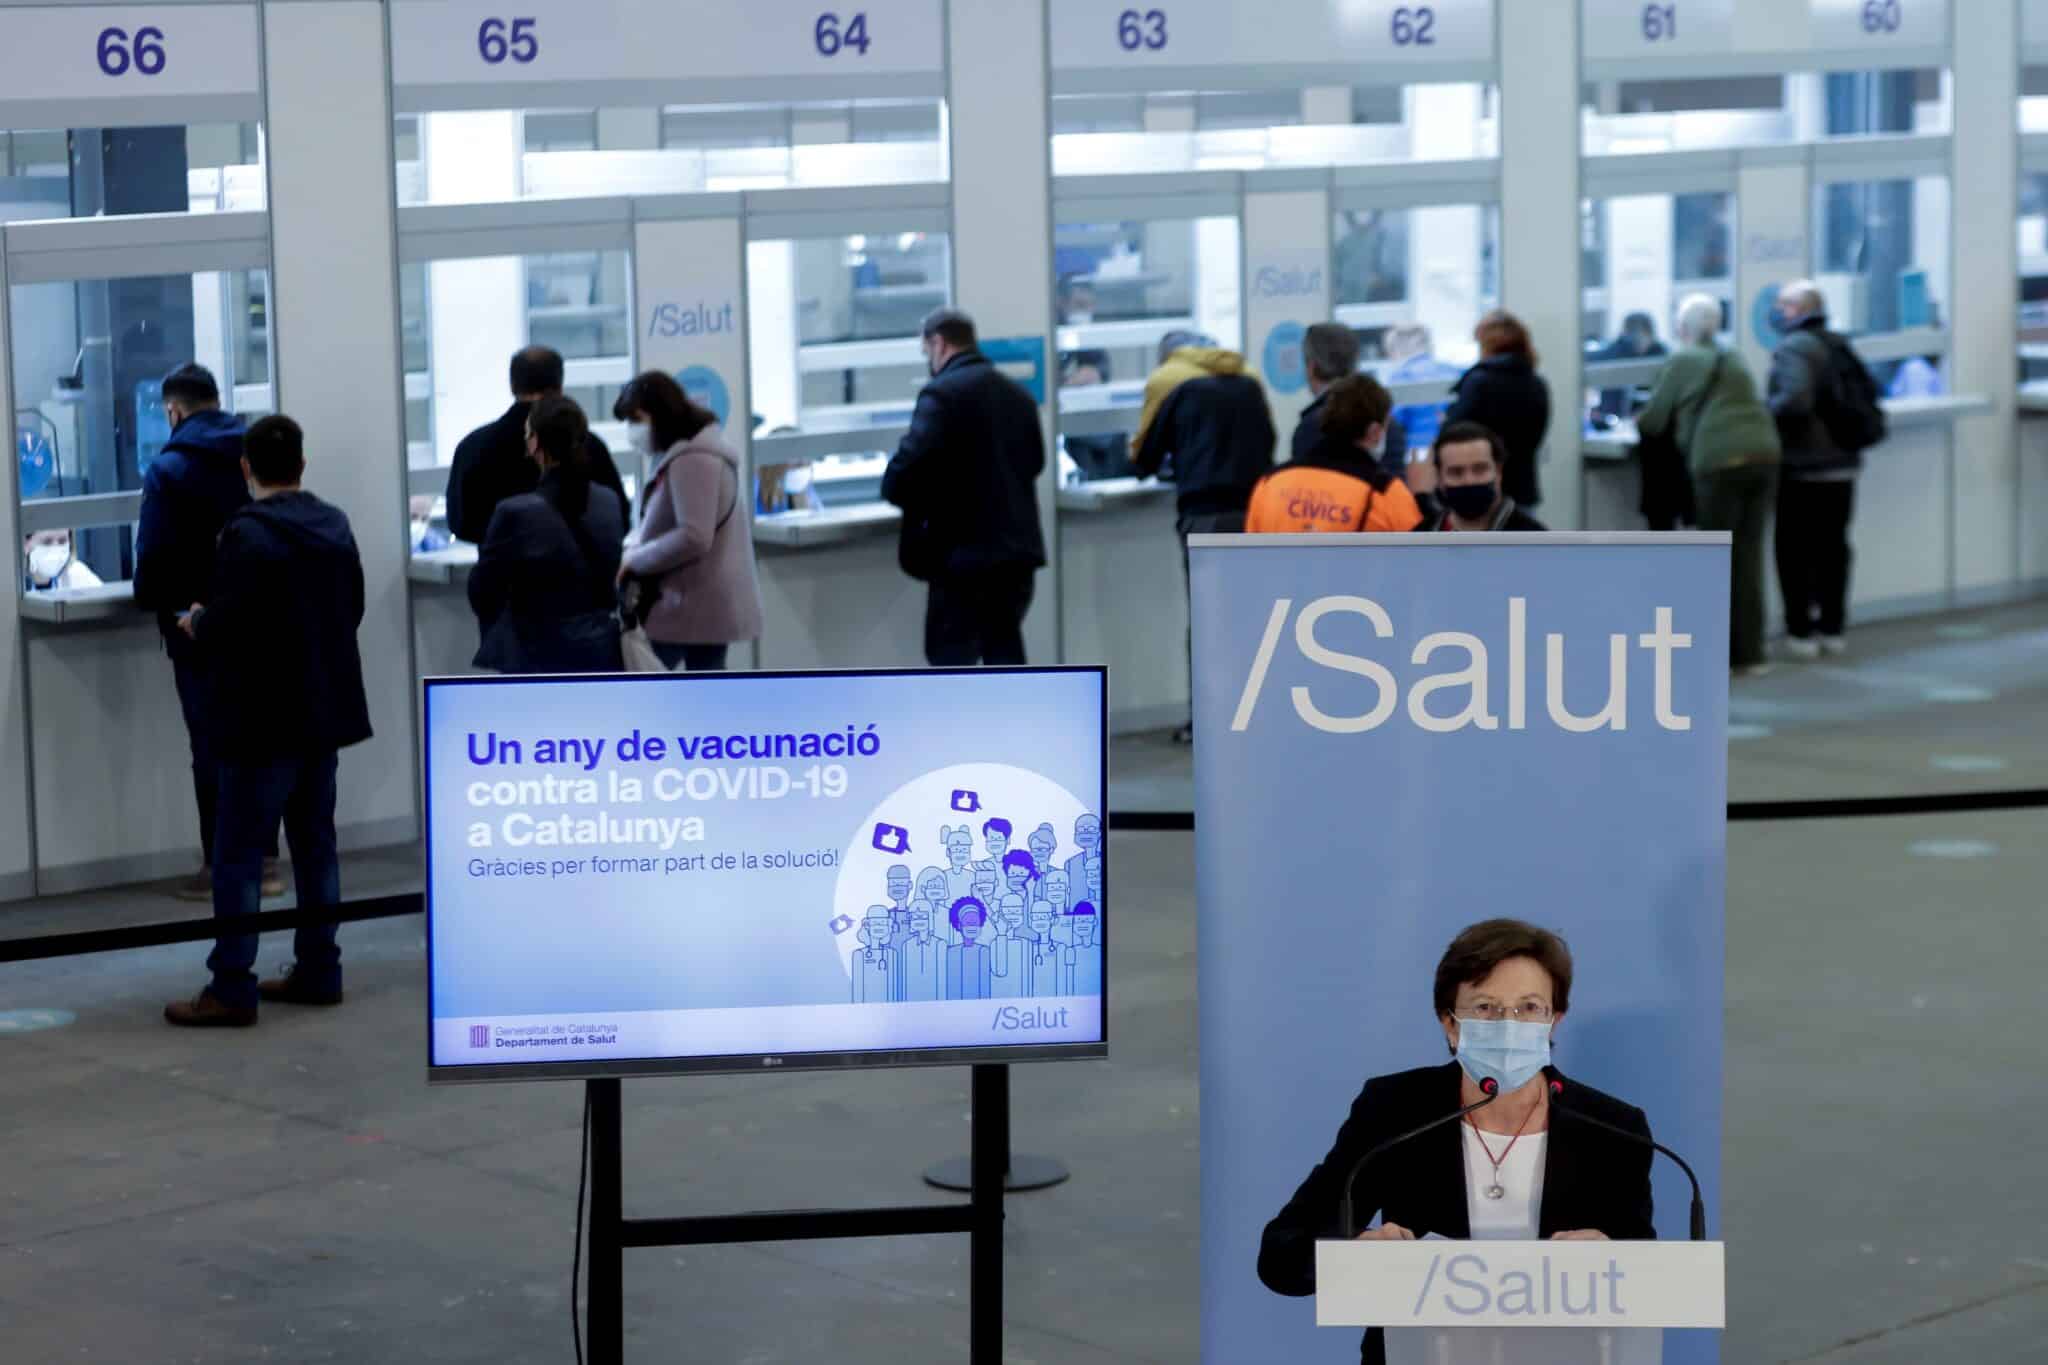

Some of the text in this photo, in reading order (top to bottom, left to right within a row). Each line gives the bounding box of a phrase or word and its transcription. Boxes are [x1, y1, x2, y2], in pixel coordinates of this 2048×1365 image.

[478, 18, 539, 64] 65
[814, 13, 870, 56] 64
[1117, 10, 1168, 51] 63
[1391, 7, 1436, 46] 62
[1642, 3, 1676, 42] 61
[97, 27, 166, 76] 66
[1231, 594, 1693, 734] /Salut
[467, 723, 881, 771] Un any de vacunació
[467, 763, 849, 806] contra la COVID-19
[468, 811, 705, 851] a Catalunya
[468, 847, 840, 880] Gràcies per formar part de la solució!
[992, 1006, 1070, 1031] /Salut
[495, 1034, 616, 1049] Departament de Salut
[1413, 1254, 1627, 1315] /Salut
